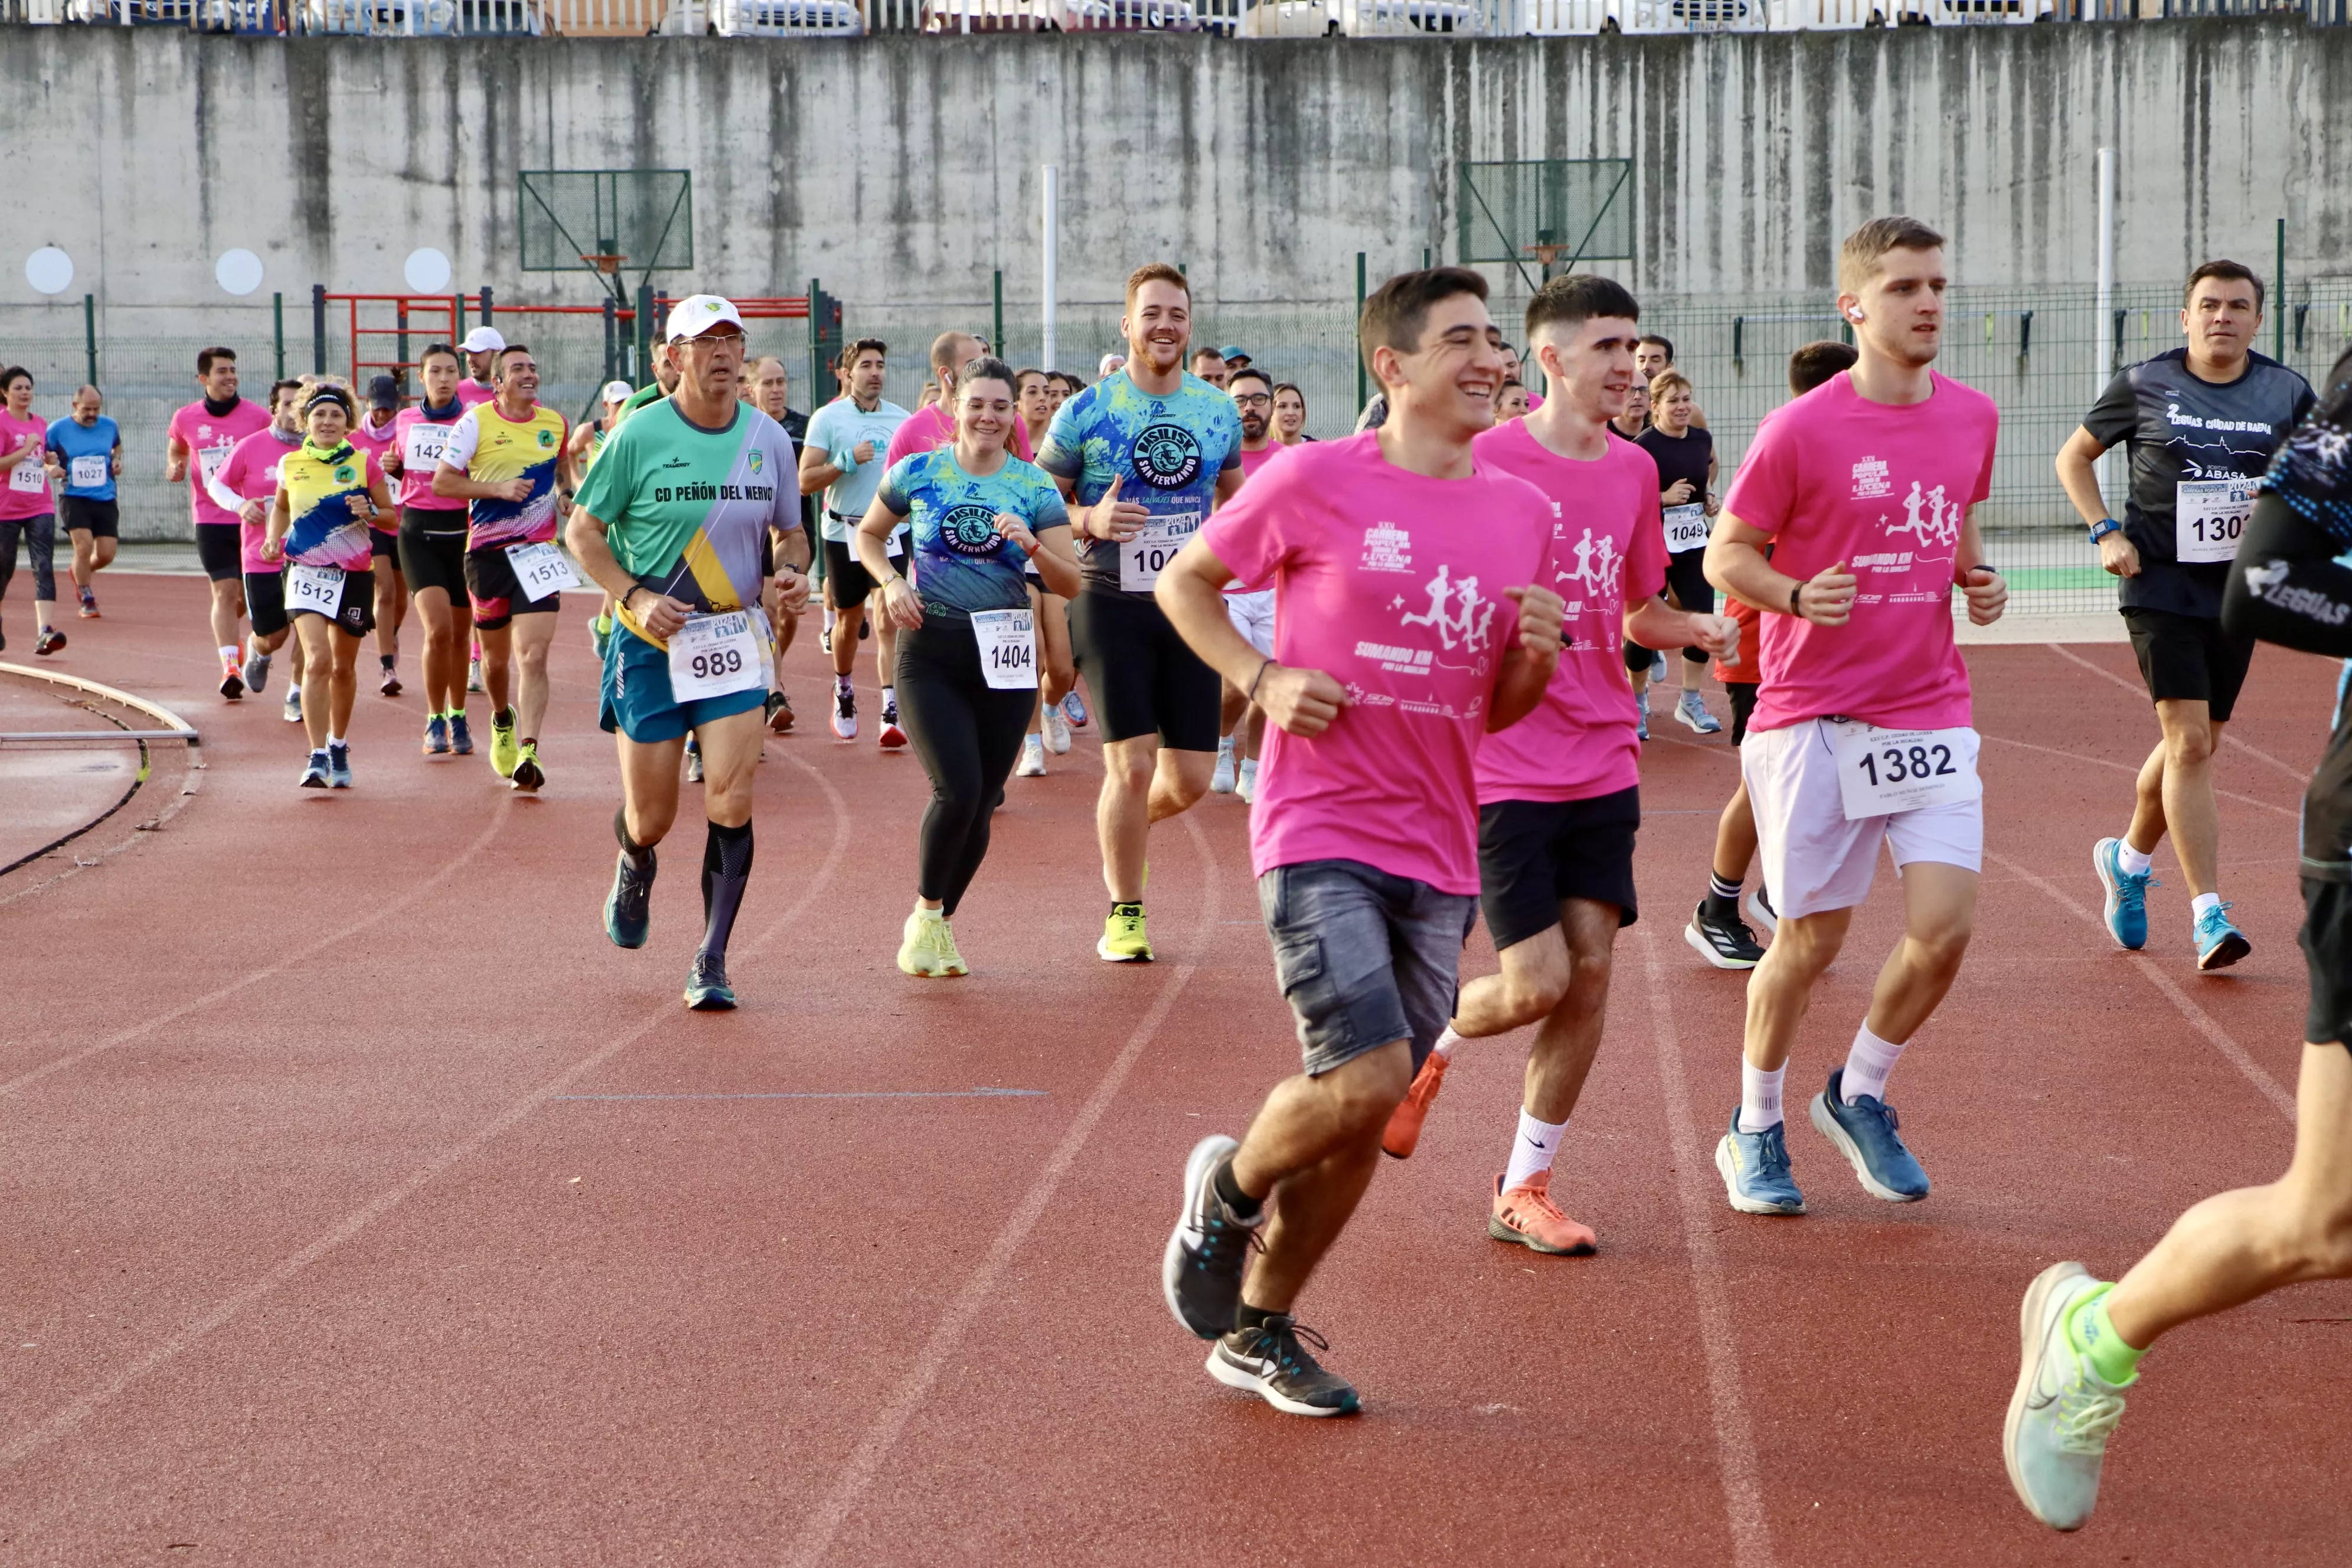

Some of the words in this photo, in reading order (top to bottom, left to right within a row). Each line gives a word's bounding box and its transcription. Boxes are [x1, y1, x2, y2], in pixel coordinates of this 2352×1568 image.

[2171, 414, 2203, 427] LEGUAS
[2206, 419, 2235, 431] CIUDAD
[2235, 421, 2246, 431] DE
[2247, 422, 2271, 435] BAENA
[1137, 428, 1194, 453] BASILISK
[18, 471, 42, 484] 1510
[79, 469, 102, 479] 1027
[1139, 460, 1154, 478] SAN
[1152, 458, 1196, 485] FERNANDO
[2205, 470, 2247, 479] ABASA
[655, 487, 671, 502] CD
[676, 481, 717, 501] PEÑÓN
[720, 485, 743, 500] DEL
[2229, 482, 2249, 491] 2024
[1167, 516, 1185, 527] 2024
[1672, 523, 1703, 540] 1049
[945, 530, 959, 545] SAN
[958, 534, 1001, 553] FERNANDO
[1361, 552, 1412, 564] LUCENA
[529, 561, 568, 584] 1513
[293, 580, 334, 605] 1512
[711, 616, 733, 627] 2024
[992, 645, 1030, 668] 1404
[1355, 641, 1414, 663] SUMANDO
[1413, 649, 1433, 665] KM
[692, 649, 742, 679] 989
[1860, 744, 1956, 786] 1382
